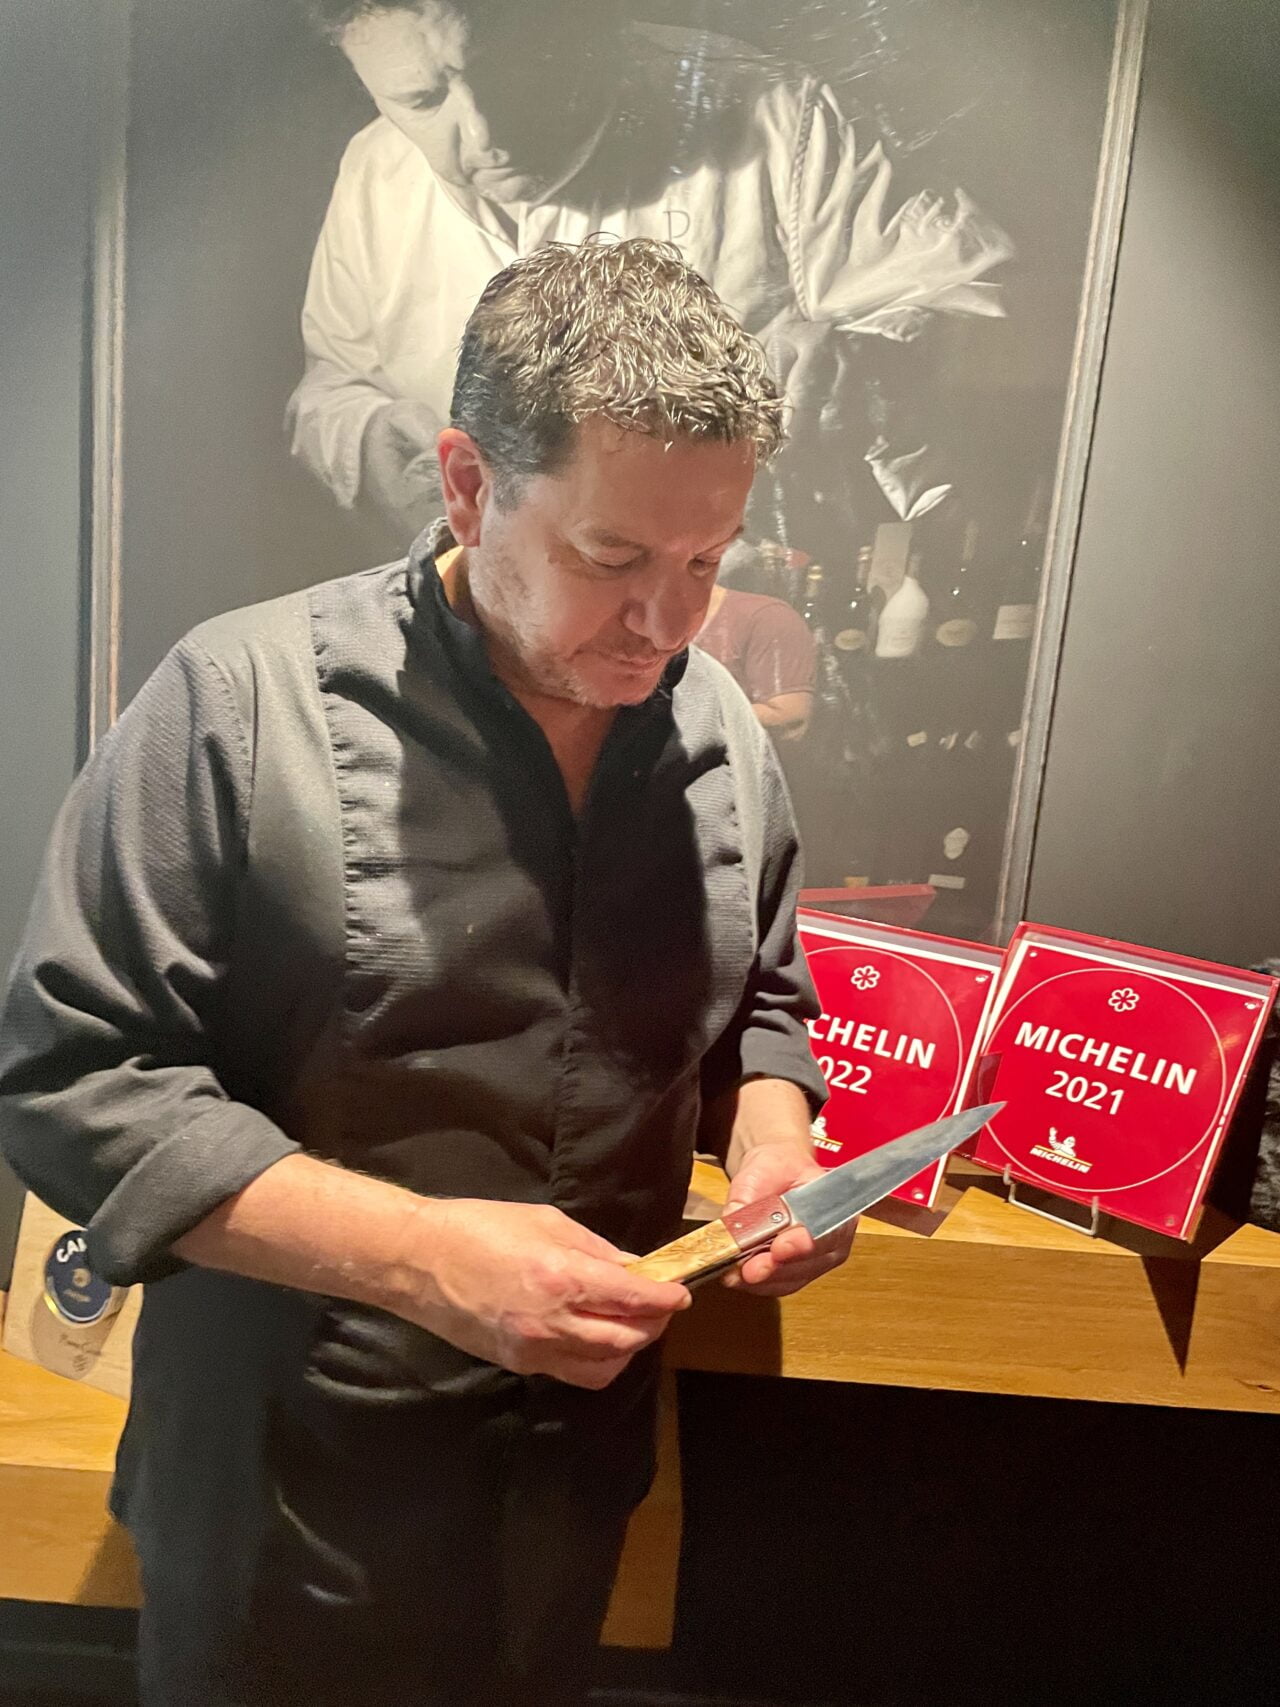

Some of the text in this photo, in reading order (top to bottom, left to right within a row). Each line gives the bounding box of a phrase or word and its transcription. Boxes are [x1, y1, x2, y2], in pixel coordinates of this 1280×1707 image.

[806, 1013, 936, 1069] CHELIN
[1014, 1021, 1197, 1095] MICHELIN
[817, 1056, 872, 1094] 022
[1045, 1070, 1124, 1115] 2021
[1029, 1147, 1092, 1174] MICHELIN
